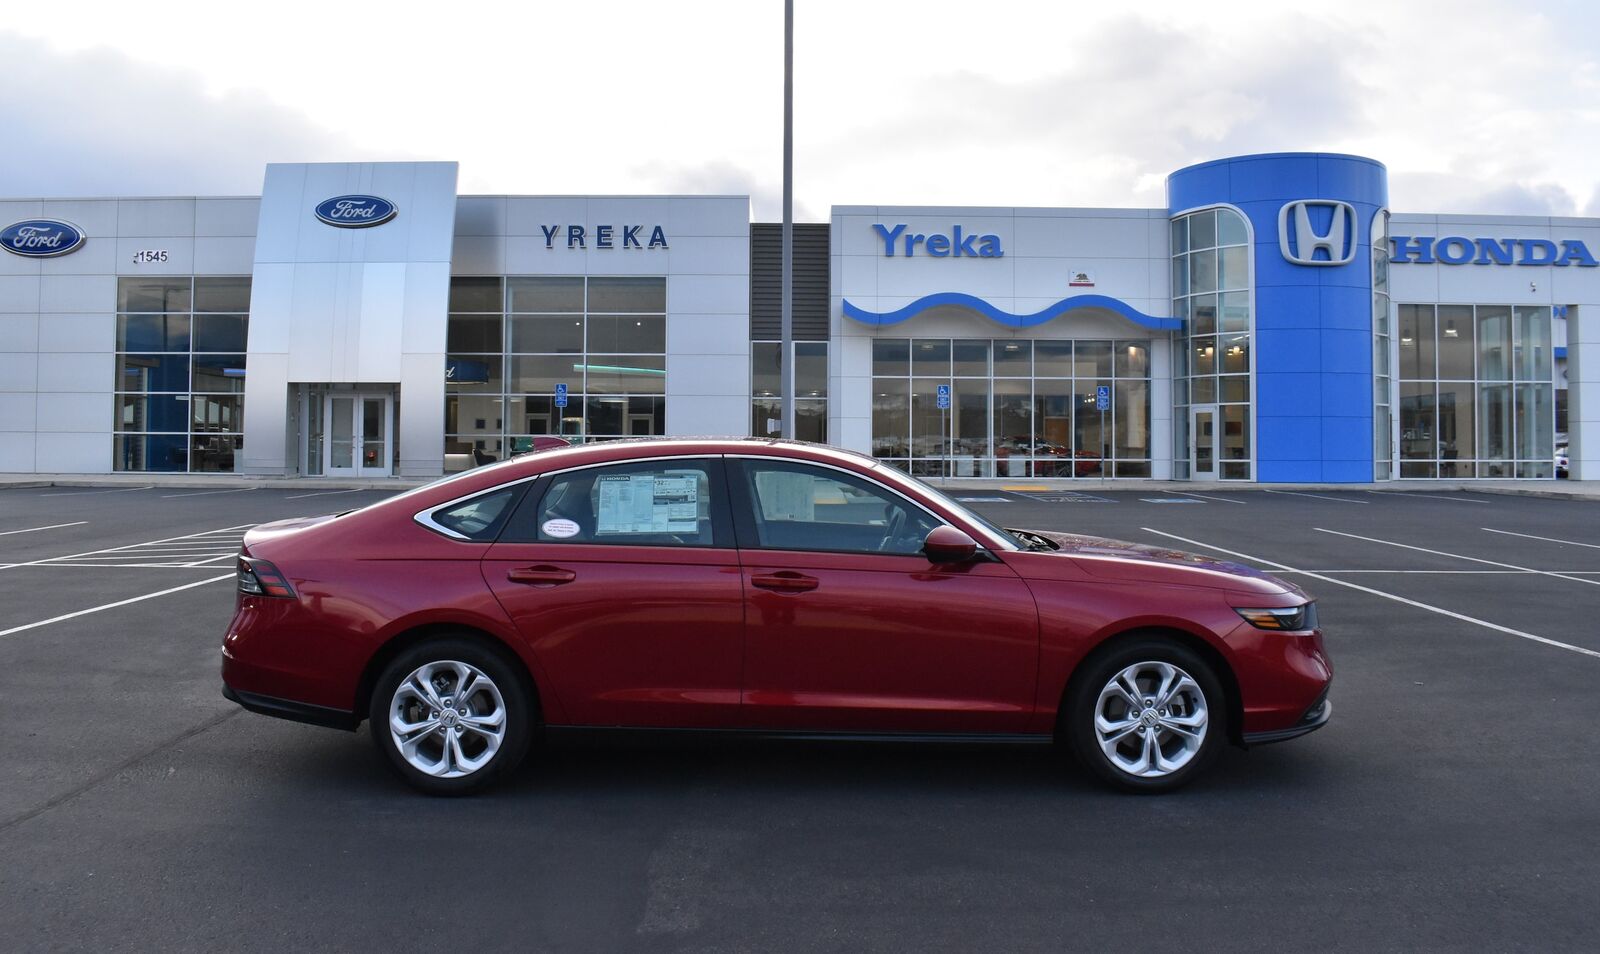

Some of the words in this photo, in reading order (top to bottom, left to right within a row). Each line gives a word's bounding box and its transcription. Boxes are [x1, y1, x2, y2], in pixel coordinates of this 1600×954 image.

[330, 200, 377, 218] Ford
[13, 226, 61, 248] Ford
[541, 225, 669, 249] YREKA
[872, 224, 1004, 257] Yreka
[139, 251, 168, 262] 1545
[1389, 236, 1599, 267] HONDA
